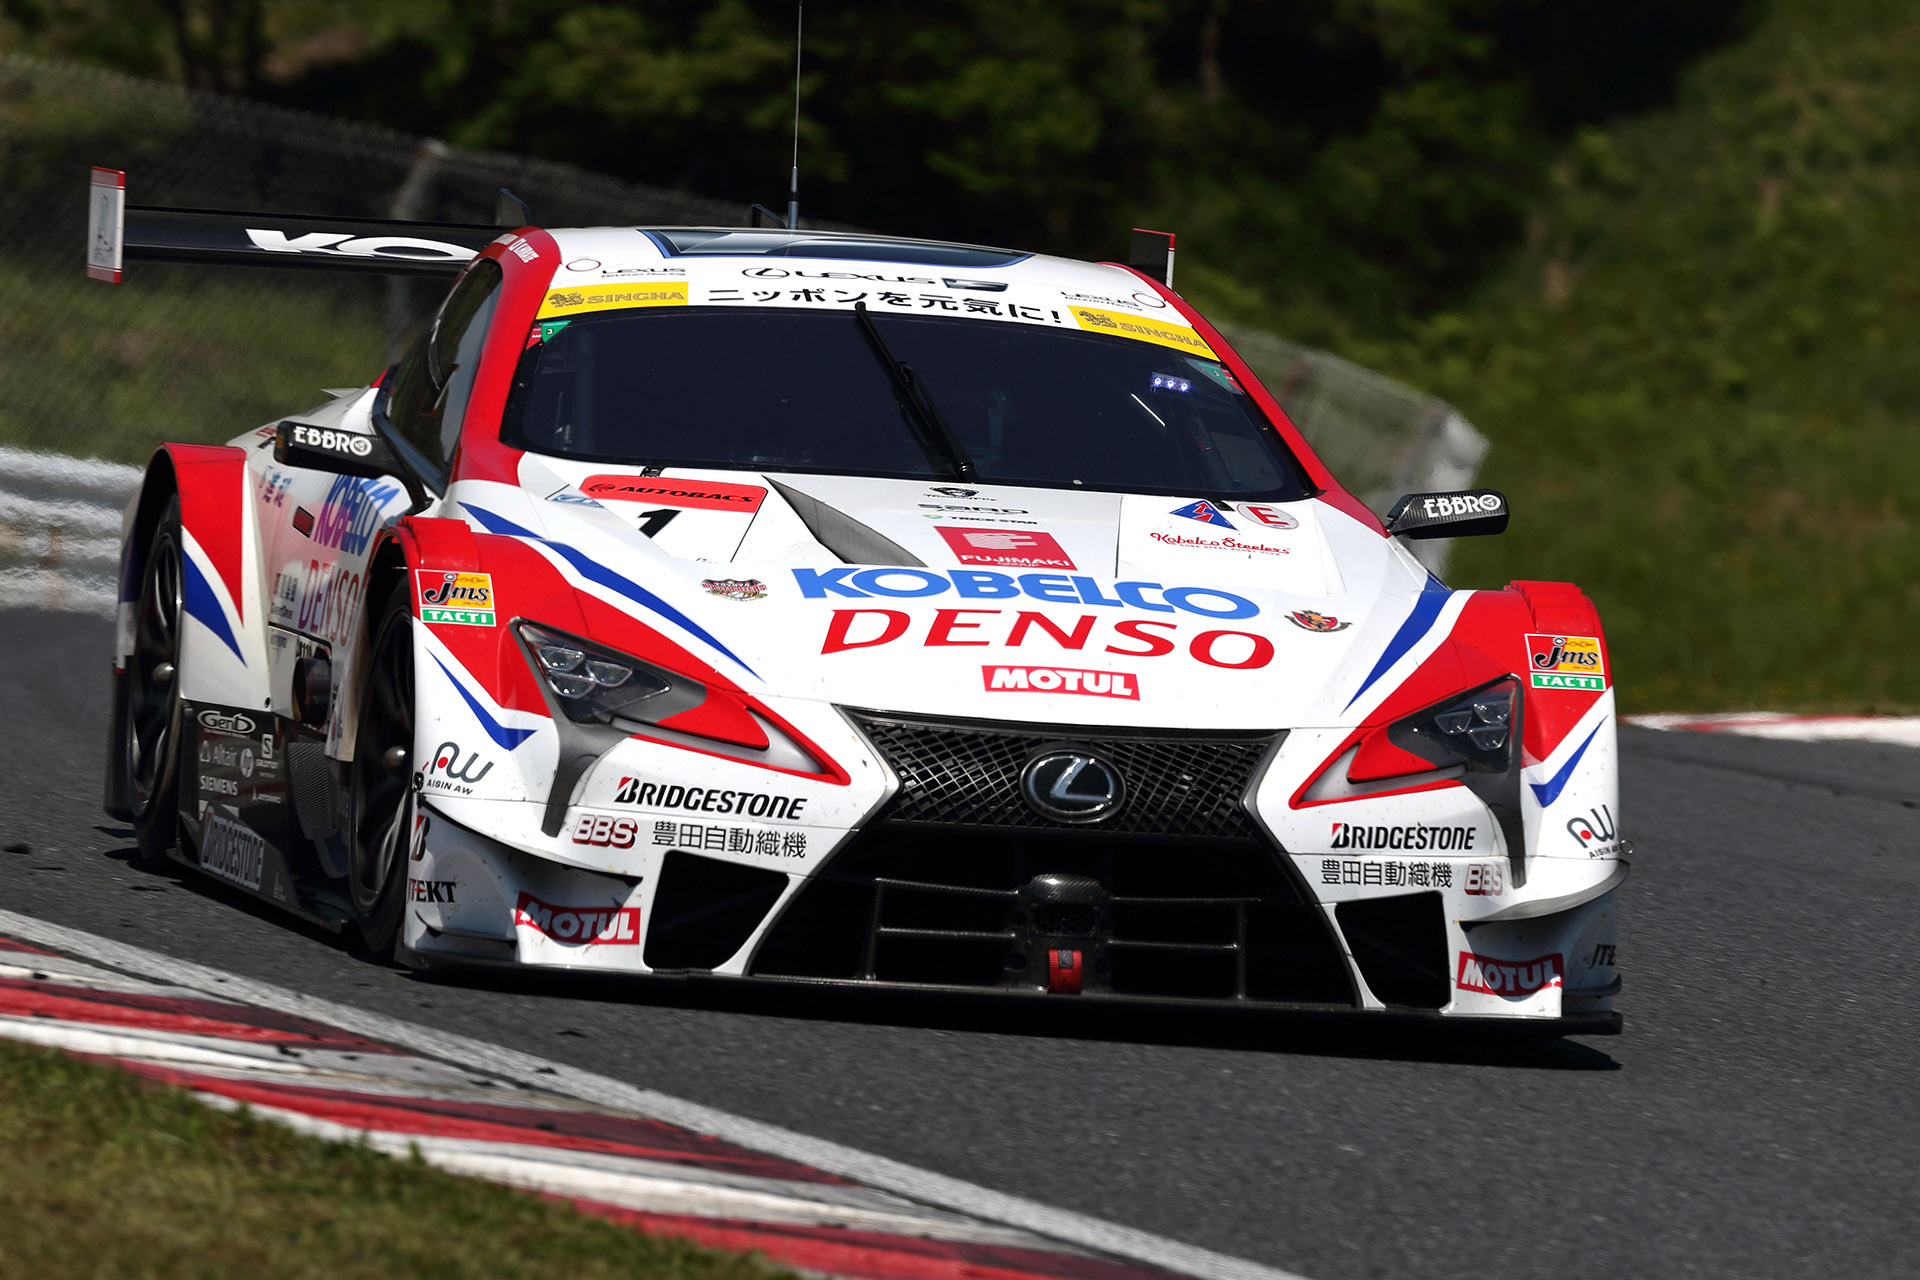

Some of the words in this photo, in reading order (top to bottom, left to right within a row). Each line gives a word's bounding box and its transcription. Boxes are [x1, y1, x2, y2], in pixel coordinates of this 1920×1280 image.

[795, 270, 936, 284] LEXUS
[586, 291, 685, 304] SINGHA
[1119, 322, 1209, 351] SINGHA
[293, 424, 372, 456] EBBRO
[616, 486, 755, 503] AUTOBACS
[1423, 494, 1501, 518] EBBRO
[637, 508, 682, 539] 1
[1150, 532, 1220, 545] Kobelco
[1222, 537, 1290, 554] Steelers
[960, 554, 1070, 567] FUJIMAKI
[791, 567, 1260, 620] KOBELCO
[428, 610, 487, 624] TACTI
[820, 608, 1275, 669] DENSO
[990, 668, 1133, 696] MOTUL
[1538, 675, 1597, 689] TACTI
[200, 775, 238, 797] SIEMENS
[426, 779, 452, 791] AISIN
[453, 785, 474, 796] AW
[614, 777, 808, 820] BRIDGESTONE
[572, 814, 639, 850] BBS
[1331, 823, 1476, 850] BRIDGESTONE
[1465, 863, 1503, 896] BBS
[520, 902, 637, 941] MOTUL
[1460, 962, 1562, 993] MOTUL
